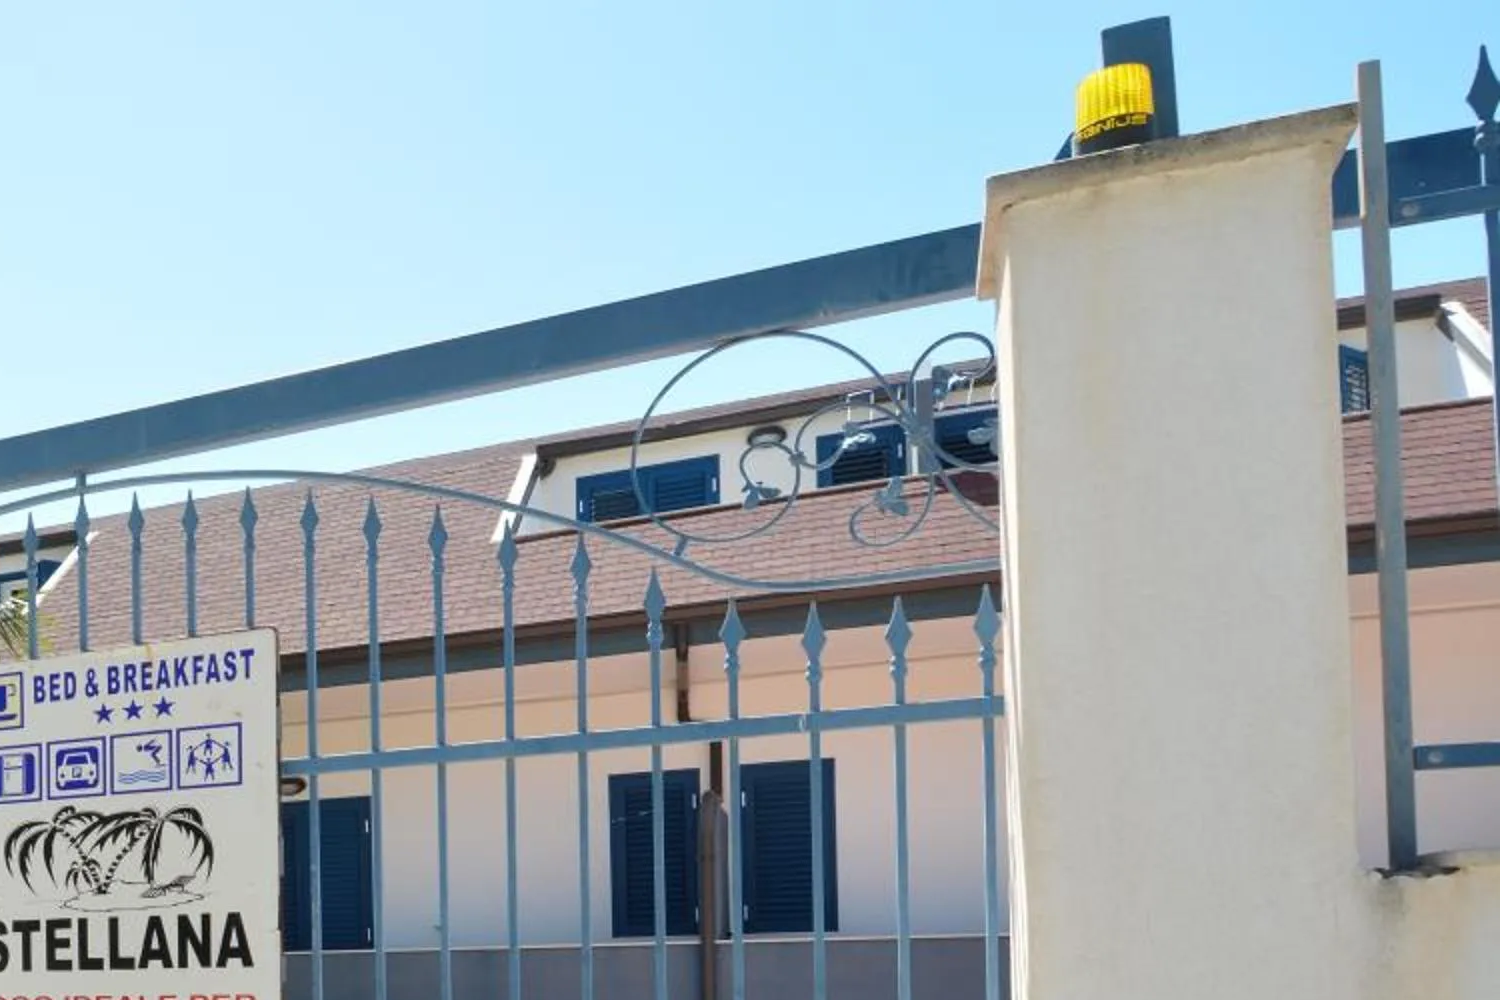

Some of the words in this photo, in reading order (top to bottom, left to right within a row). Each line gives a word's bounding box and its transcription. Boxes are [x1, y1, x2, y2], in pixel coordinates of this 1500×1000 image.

[33, 671, 77, 704] BED
[85, 668, 99, 698] &
[107, 648, 255, 695] BREAKFAST
